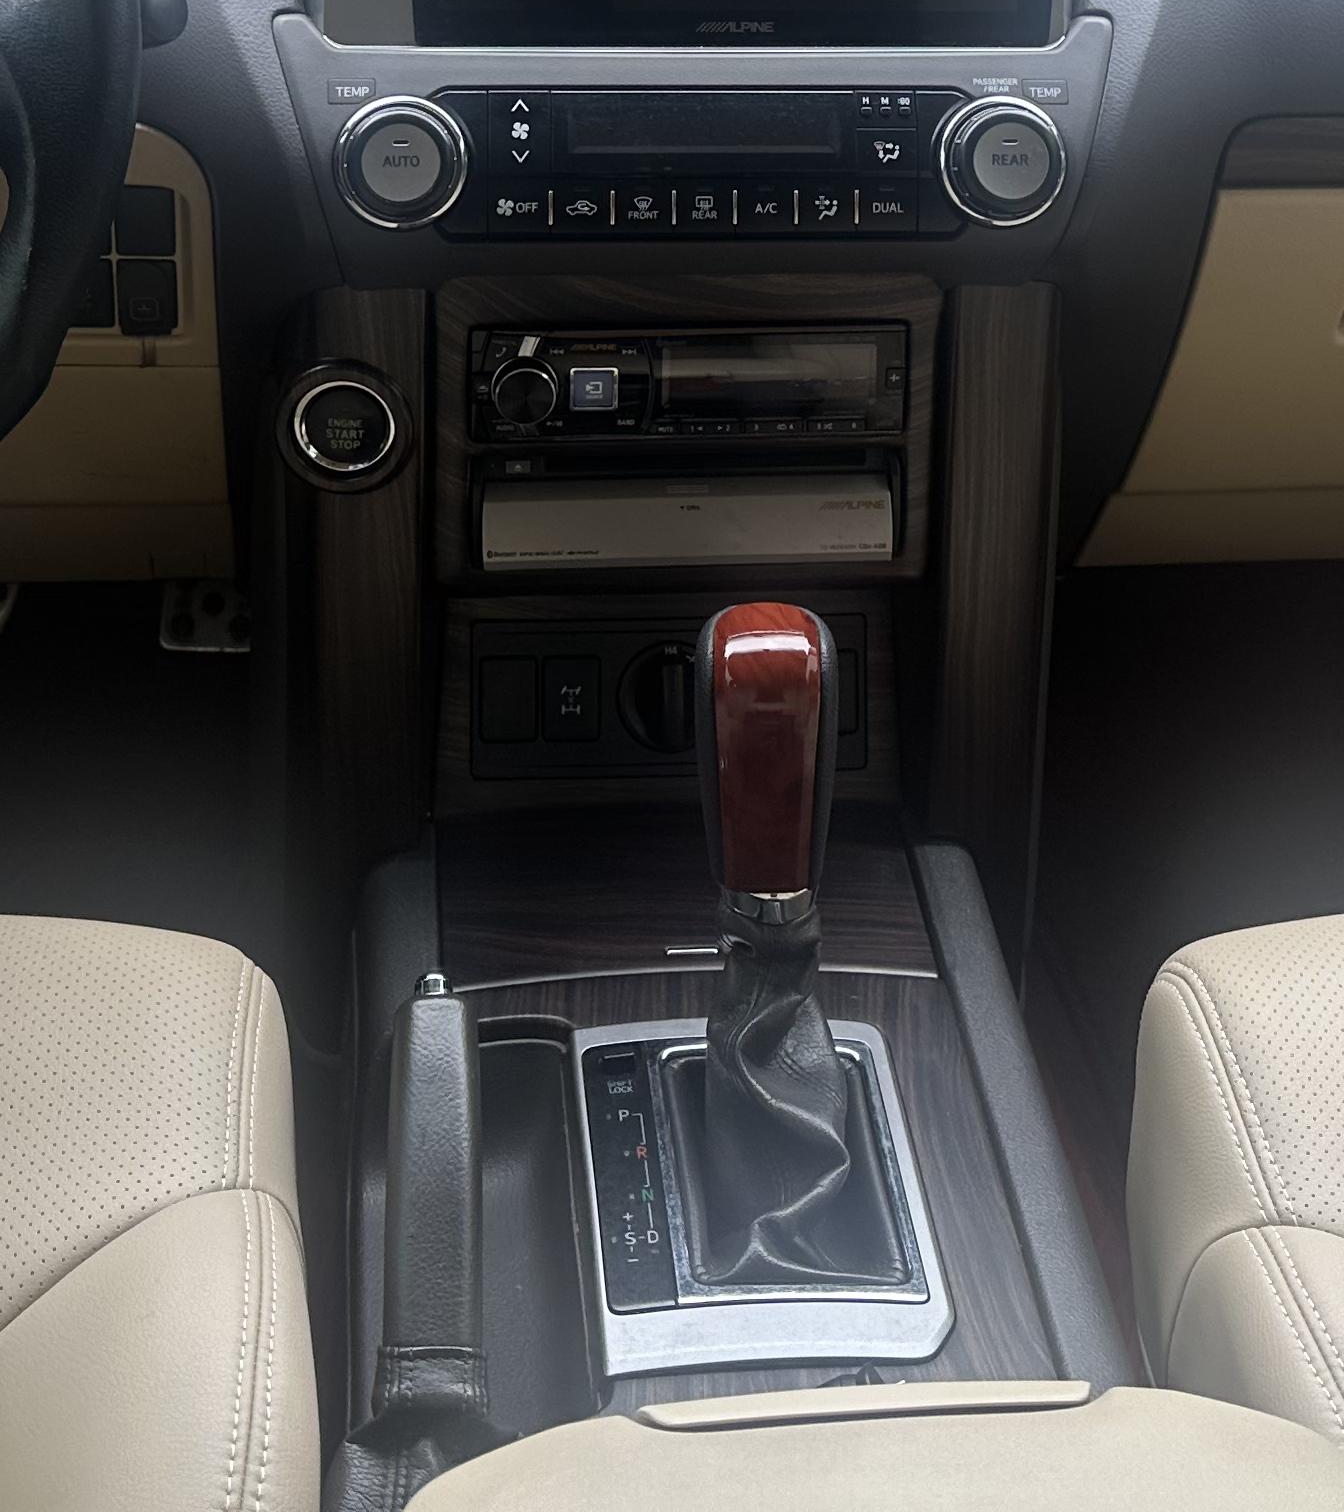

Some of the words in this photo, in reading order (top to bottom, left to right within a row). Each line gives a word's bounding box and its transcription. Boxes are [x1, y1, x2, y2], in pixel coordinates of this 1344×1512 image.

[972, 77, 1018, 86] PASSENGER
[335, 86, 370, 98] TEMP
[1029, 87, 1062, 99] TEMP
[880, 97, 890, 105] M
[382, 155, 421, 169] AUTO
[991, 153, 1030, 167] REAR
[515, 202, 539, 214] OFF
[755, 202, 778, 215] A/C
[872, 202, 904, 214] DUAL
[628, 211, 660, 221] FRONT
[692, 210, 718, 220] REAR
[327, 417, 363, 428] ENGINE
[325, 428, 365, 439] START
[329, 439, 361, 450] STOP
[608, 1086, 634, 1095] LOCK
[618, 1109, 629, 1121] P
[636, 1147, 647, 1159] R
[642, 1189, 654, 1201] N
[624, 1232, 636, 1245] S
[647, 1231, 659, 1243] D
